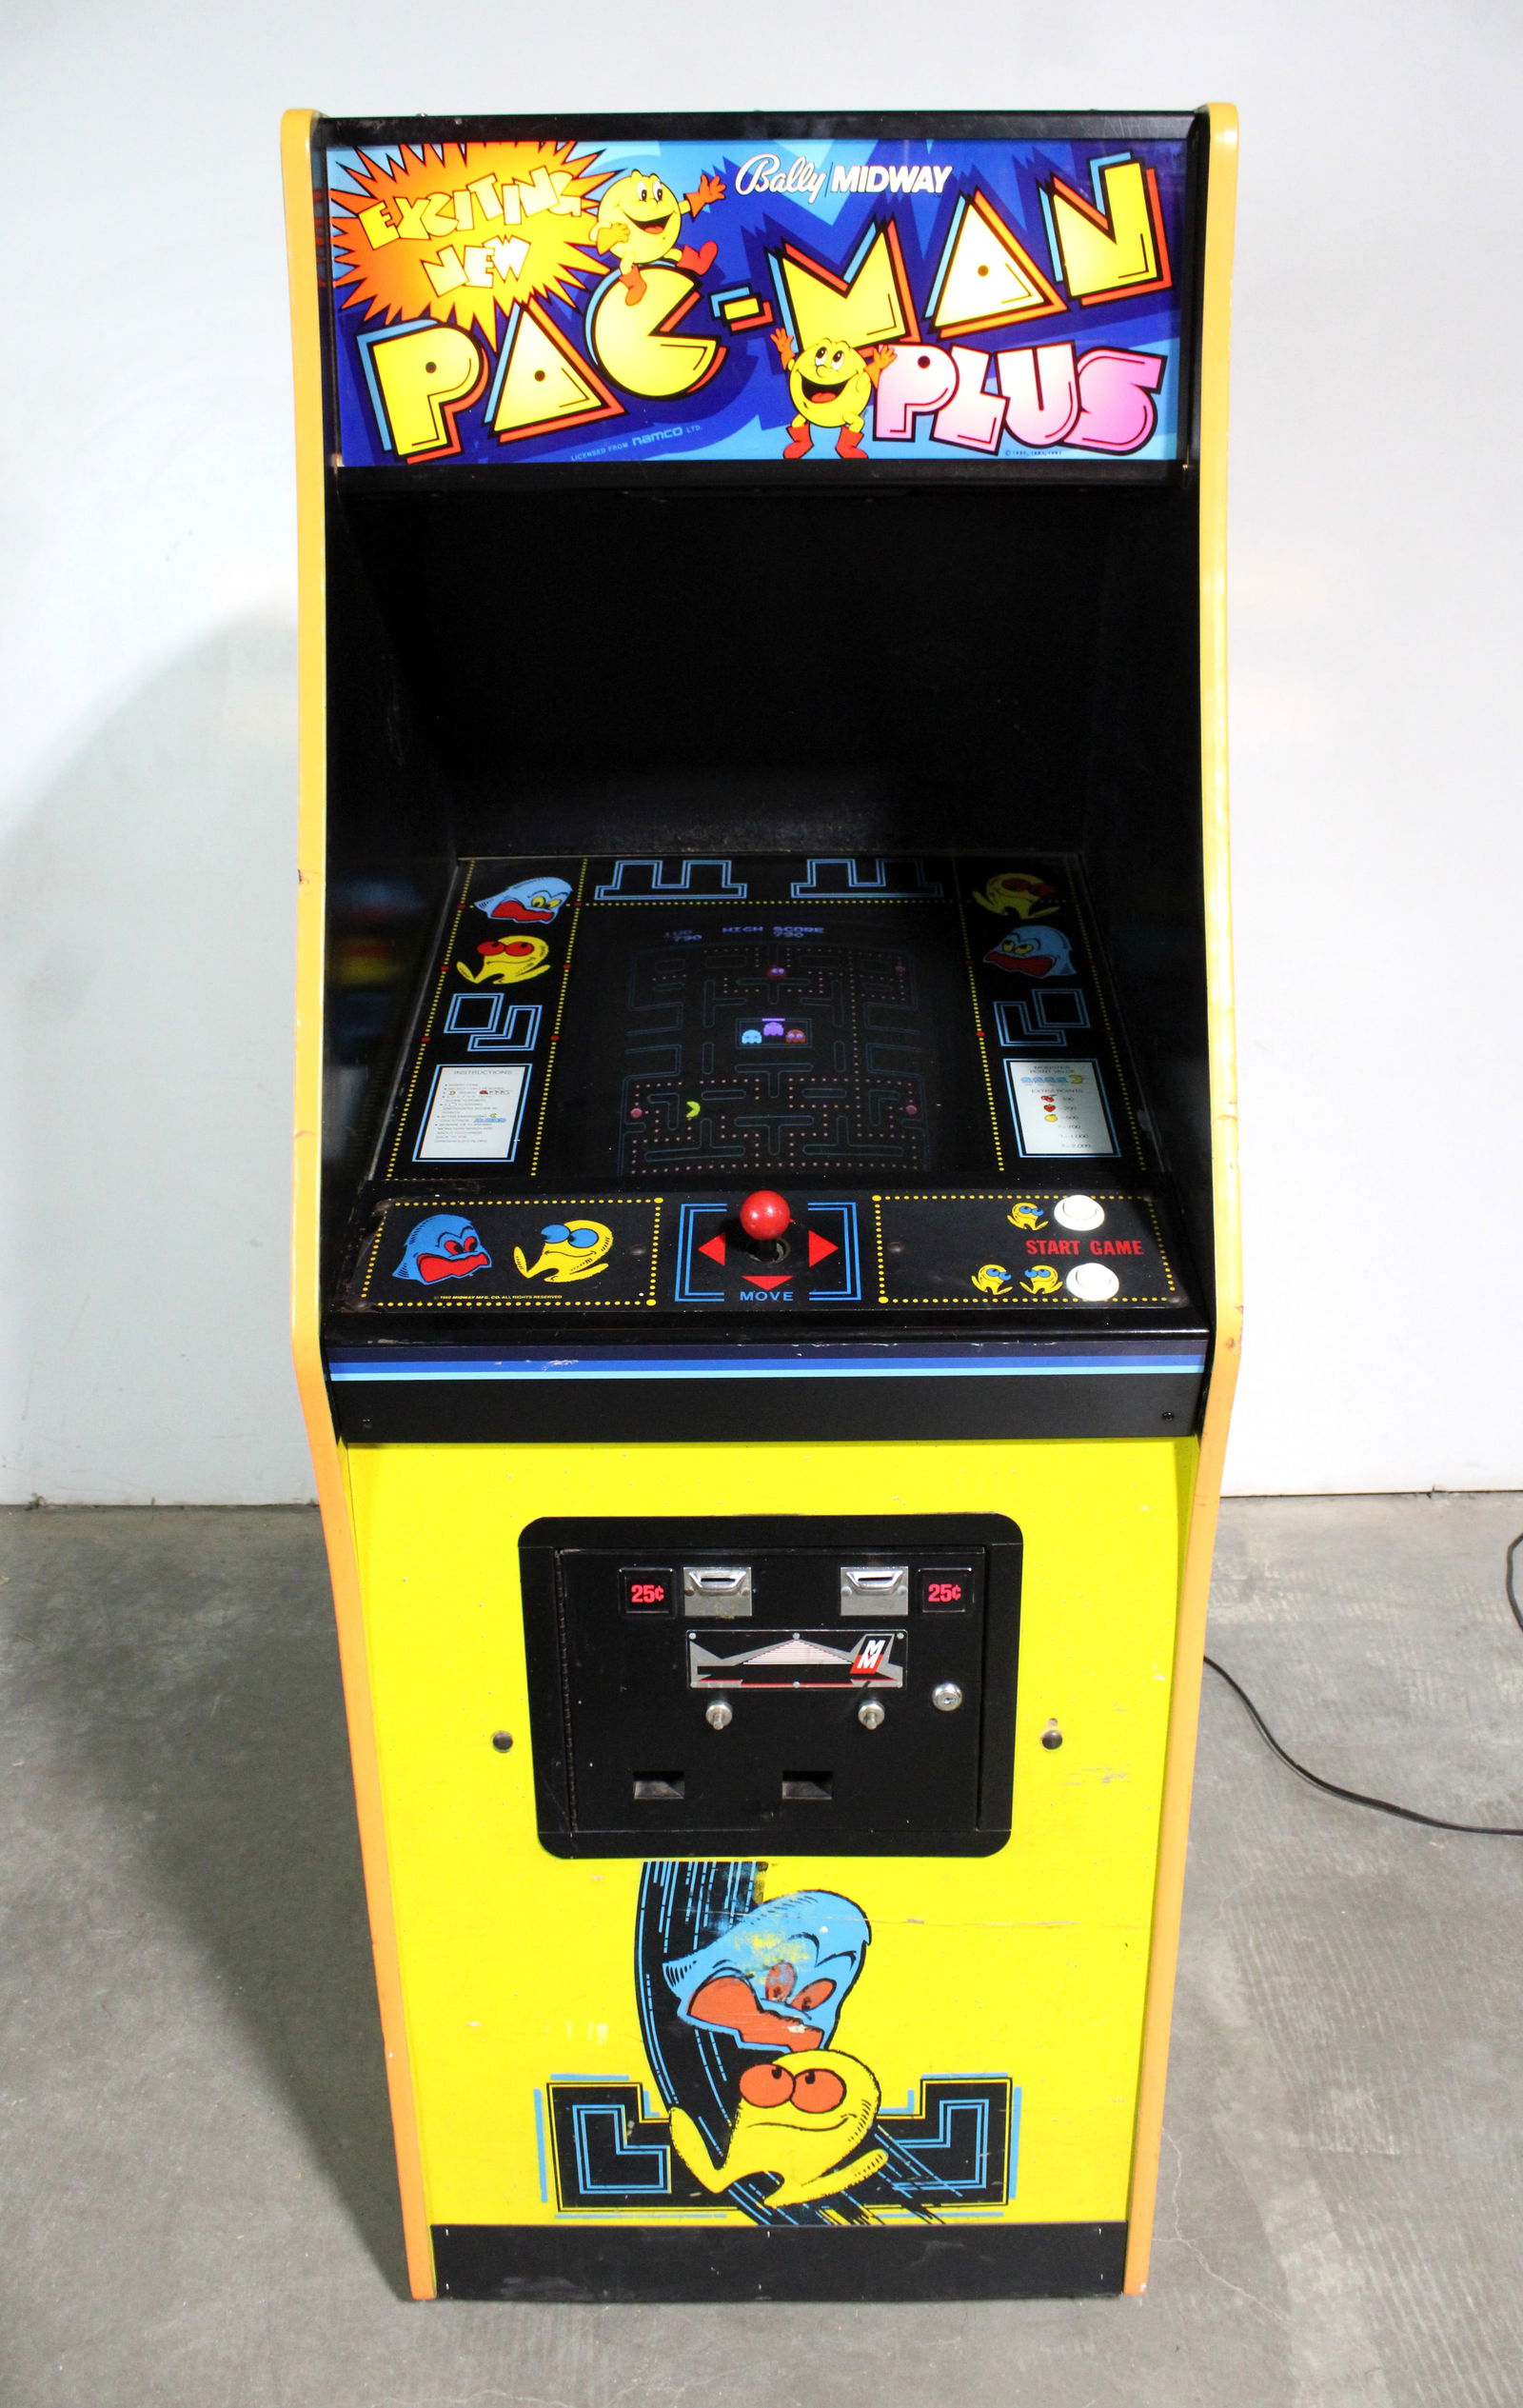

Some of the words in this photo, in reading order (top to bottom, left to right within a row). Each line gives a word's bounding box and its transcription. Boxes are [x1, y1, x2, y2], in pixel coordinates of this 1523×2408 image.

[735, 152, 826, 204] Bally
[831, 165, 953, 193] MIDWAY
[359, 166, 583, 249] EXCITING
[422, 234, 531, 297] NEW
[873, 340, 1168, 456] PLUS
[608, 442, 628, 452] FROM
[773, 925, 824, 934] SCORE
[1026, 1240, 1082, 1256] START
[1091, 1240, 1144, 1256] GAME
[740, 1290, 794, 1302] MOVE
[631, 1584, 664, 1603] 25¢
[928, 1583, 962, 1602] 25¢
